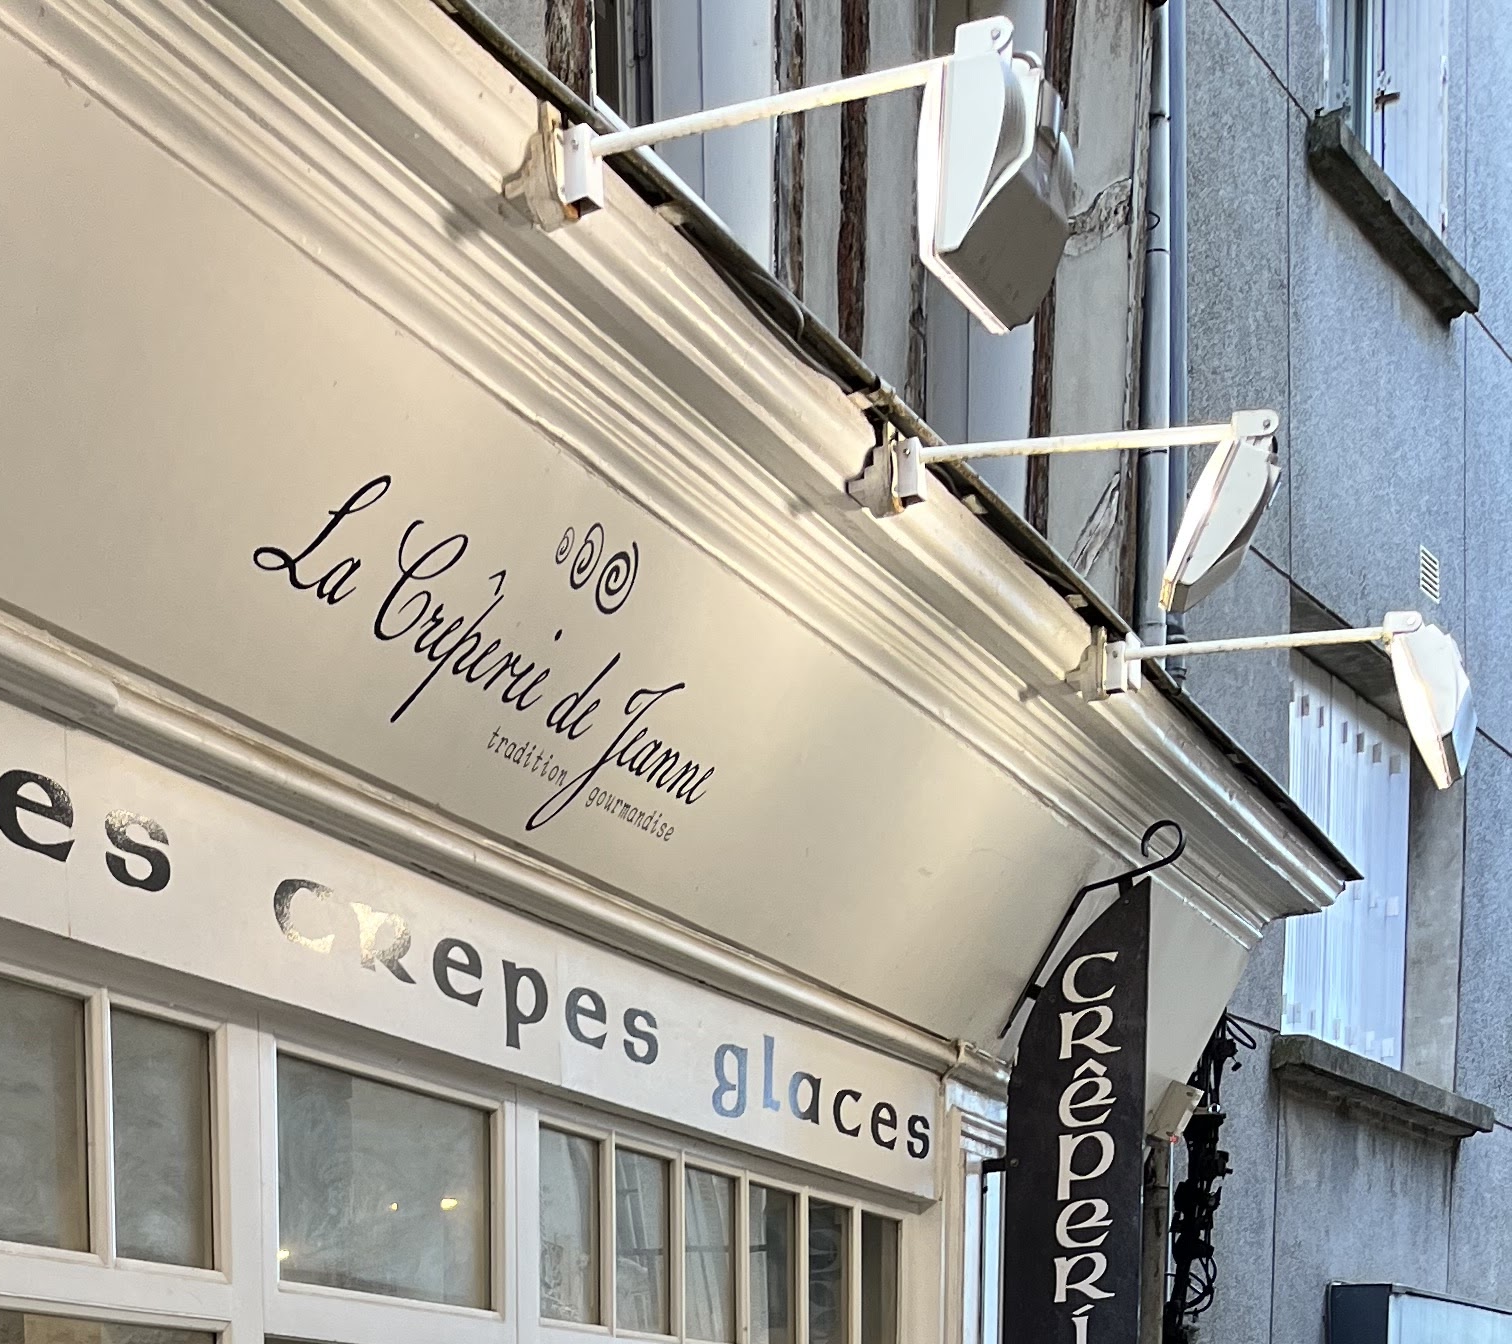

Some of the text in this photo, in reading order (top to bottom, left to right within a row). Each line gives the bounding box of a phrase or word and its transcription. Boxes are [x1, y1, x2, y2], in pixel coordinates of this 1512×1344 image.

[253, 475, 392, 605] La
[525, 682, 716, 831] Jeanne
[546, 652, 621, 741] de
[488, 726, 676, 842] tradition gourmandise
[711, 1034, 931, 1160] glaces
